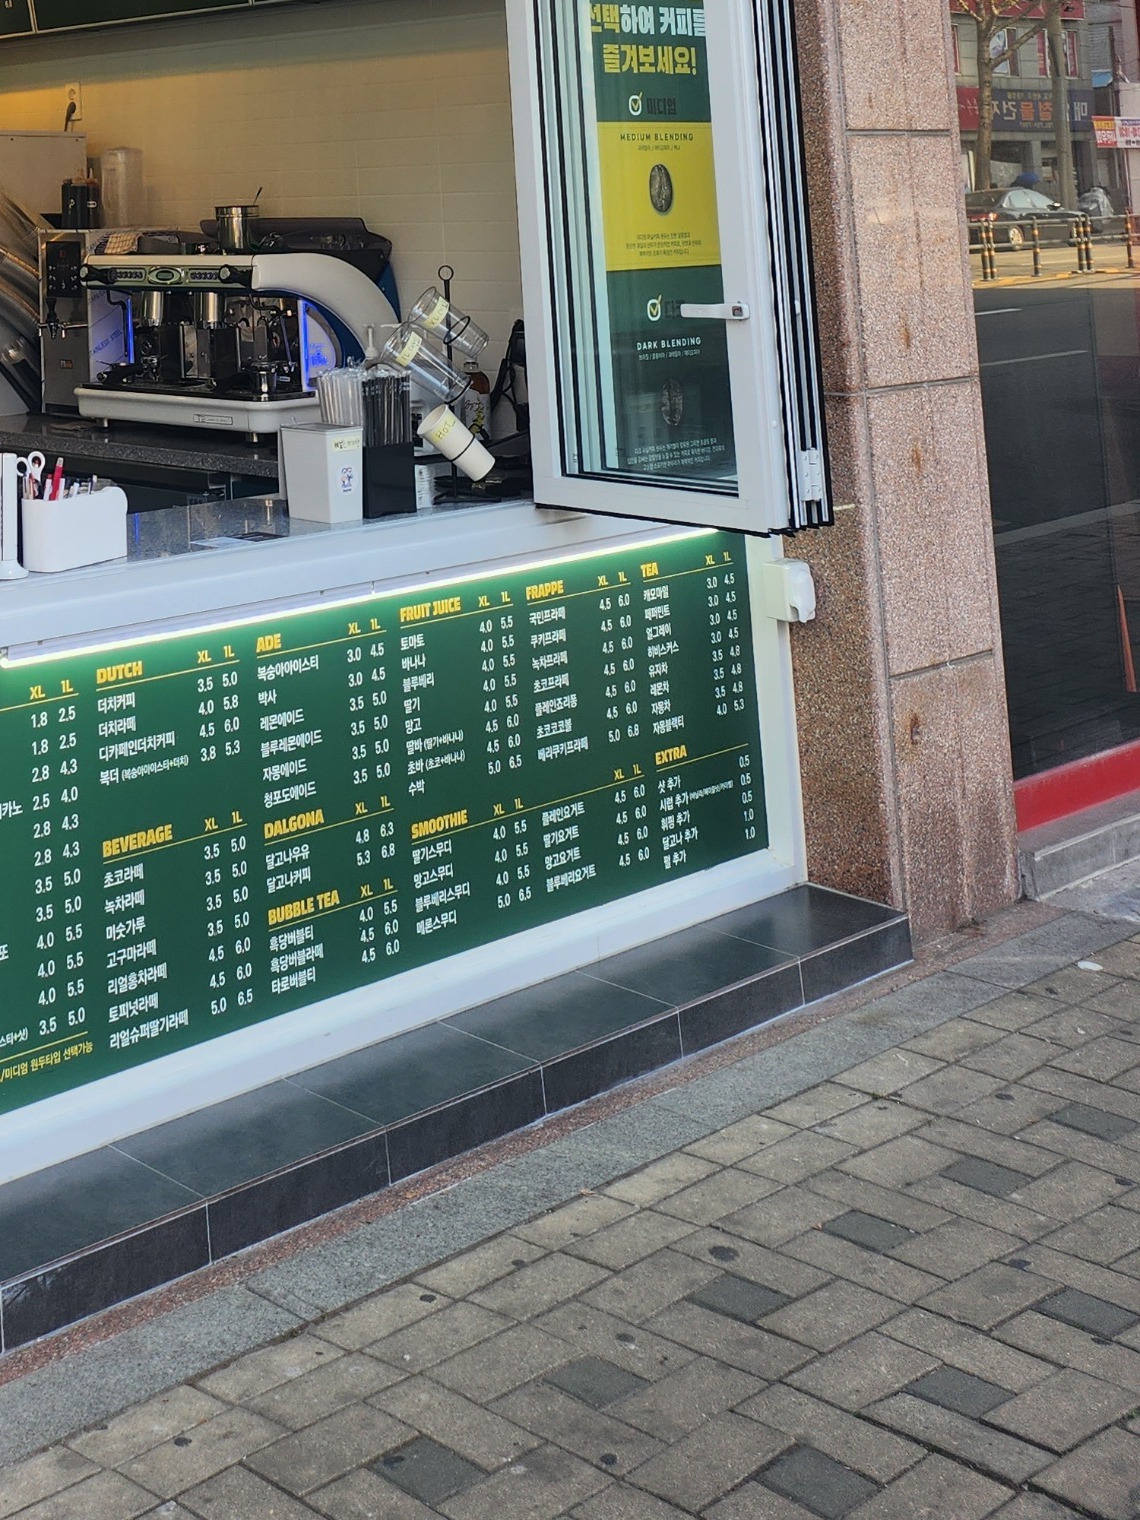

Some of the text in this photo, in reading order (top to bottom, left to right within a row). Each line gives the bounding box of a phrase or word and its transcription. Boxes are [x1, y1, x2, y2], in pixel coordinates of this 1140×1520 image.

[602, 43, 697, 76] 즐겨보세요!
[620, 132, 694, 141] MEDIUM BLENDING
[636, 336, 702, 351] DARK BLENDING
[640, 561, 659, 578] TEA
[525, 579, 564, 601] FRAPPE
[399, 596, 462, 623] FRUIT JUICE
[255, 632, 282, 654] ADE
[400, 633, 426, 651] 토마토
[96, 660, 143, 685] DUTCH
[401, 653, 427, 672] 바나나
[29, 685, 46, 700] XL
[402, 671, 435, 693] 블루베리
[97, 691, 136, 714] 더치커피
[257, 688, 278, 707] 박사
[403, 696, 421, 714] 딸기
[30, 711, 48, 729] 1.8
[58, 705, 76, 723] 2.5
[98, 715, 137, 738] 더치라떼
[259, 708, 305, 732] 레몬에이드
[404, 717, 423, 735] 망고
[31, 738, 49, 756] 1.8
[59, 732, 77, 750] 2.5
[98, 730, 176, 762] 디카페인더치커피
[260, 729, 323, 759] 블루레몬에이드
[655, 744, 688, 766] EXTRA
[31, 764, 50, 783] 2.8
[59, 758, 78, 775] 4.3
[262, 758, 308, 782] 자몽에이드
[263, 780, 317, 809] 청포도에이드
[408, 778, 425, 797] 수박
[657, 779, 666, 795] 샷
[666, 774, 682, 791] 추가
[32, 793, 50, 811] 2.5
[60, 785, 79, 803] 4.0
[263, 808, 325, 840] DALGONA
[411, 808, 468, 840] SMOOTHIE
[102, 823, 173, 858] BEVERAGE
[412, 838, 452, 865] 딸기스무디
[265, 843, 310, 871] 달고나우유
[544, 846, 582, 871] 망고요거트
[103, 862, 144, 889] 초코라떼
[266, 865, 311, 894] 달고나커피
[413, 862, 454, 889] 망고스무디
[104, 888, 145, 915] 녹차라떼
[267, 889, 340, 926] BUBBLE TEA
[414, 881, 471, 914] 블루베리스무디
[105, 915, 146, 942] 미숫가루
[269, 924, 314, 952] 흑당버블티
[106, 938, 157, 969] 고구마라떼
[107, 962, 168, 995] 리얼홍차라떼
[271, 966, 316, 995] 타로버블티
[108, 991, 159, 1023] 토피넛라떼
[109, 1008, 189, 1049] 리얼슈퍼딸기라떼
